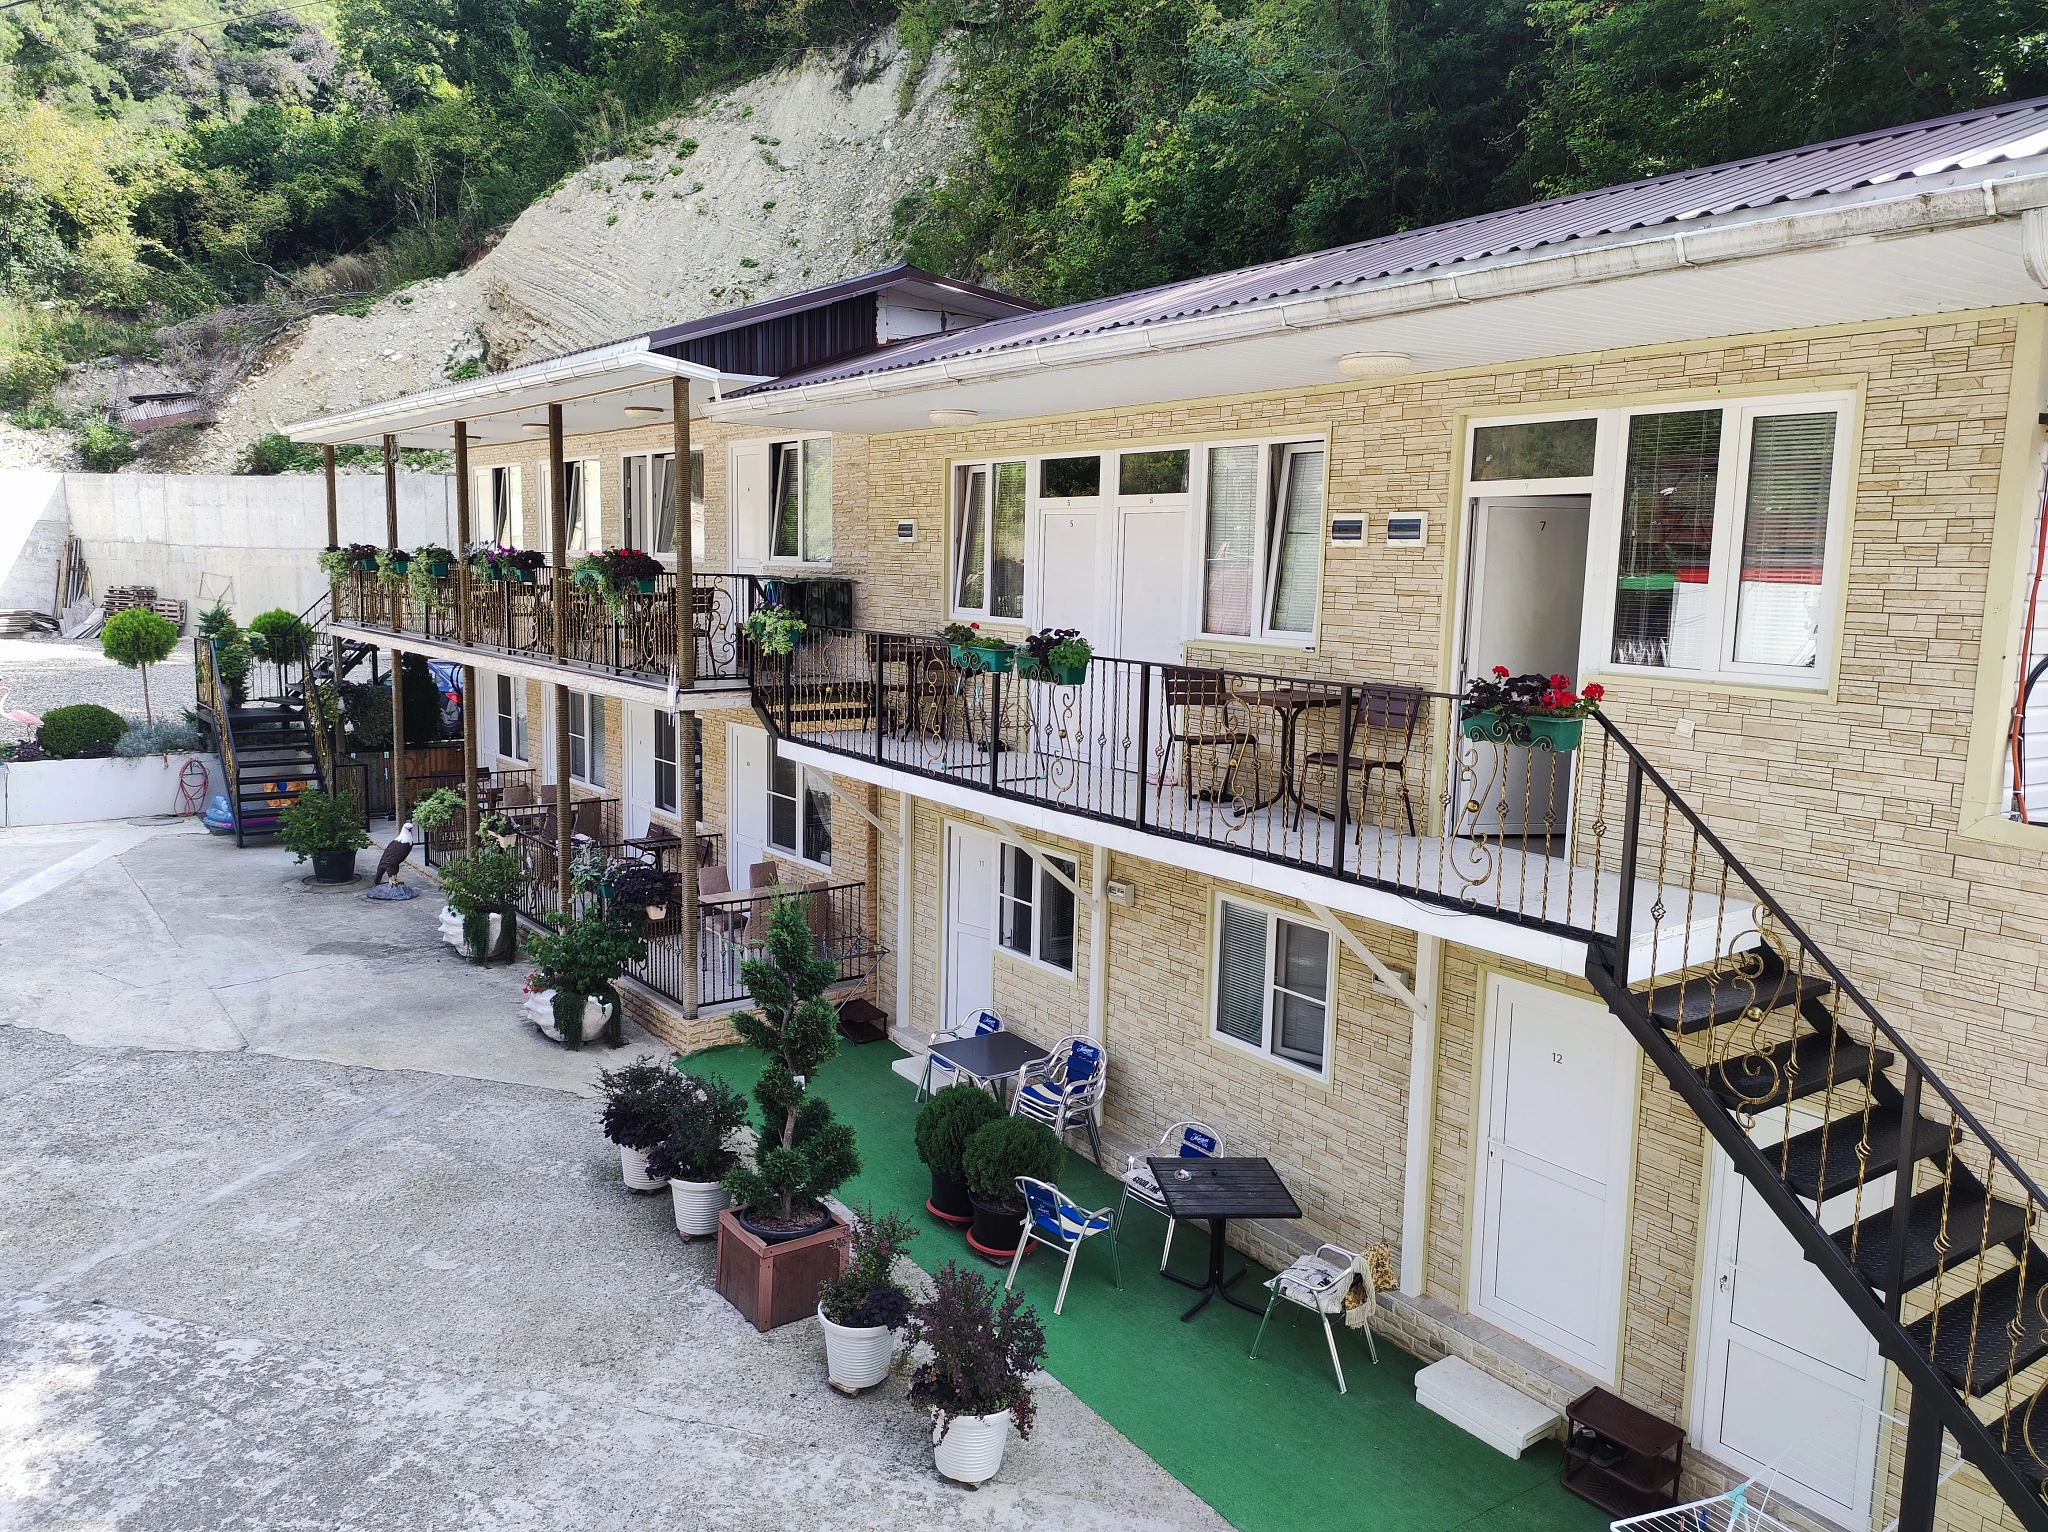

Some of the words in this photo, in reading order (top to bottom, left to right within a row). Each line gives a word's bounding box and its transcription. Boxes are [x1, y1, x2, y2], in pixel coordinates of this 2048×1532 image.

[1069, 519, 1074, 528] 5
[1540, 521, 1547, 531] 7
[1552, 1052, 1563, 1065] 12
